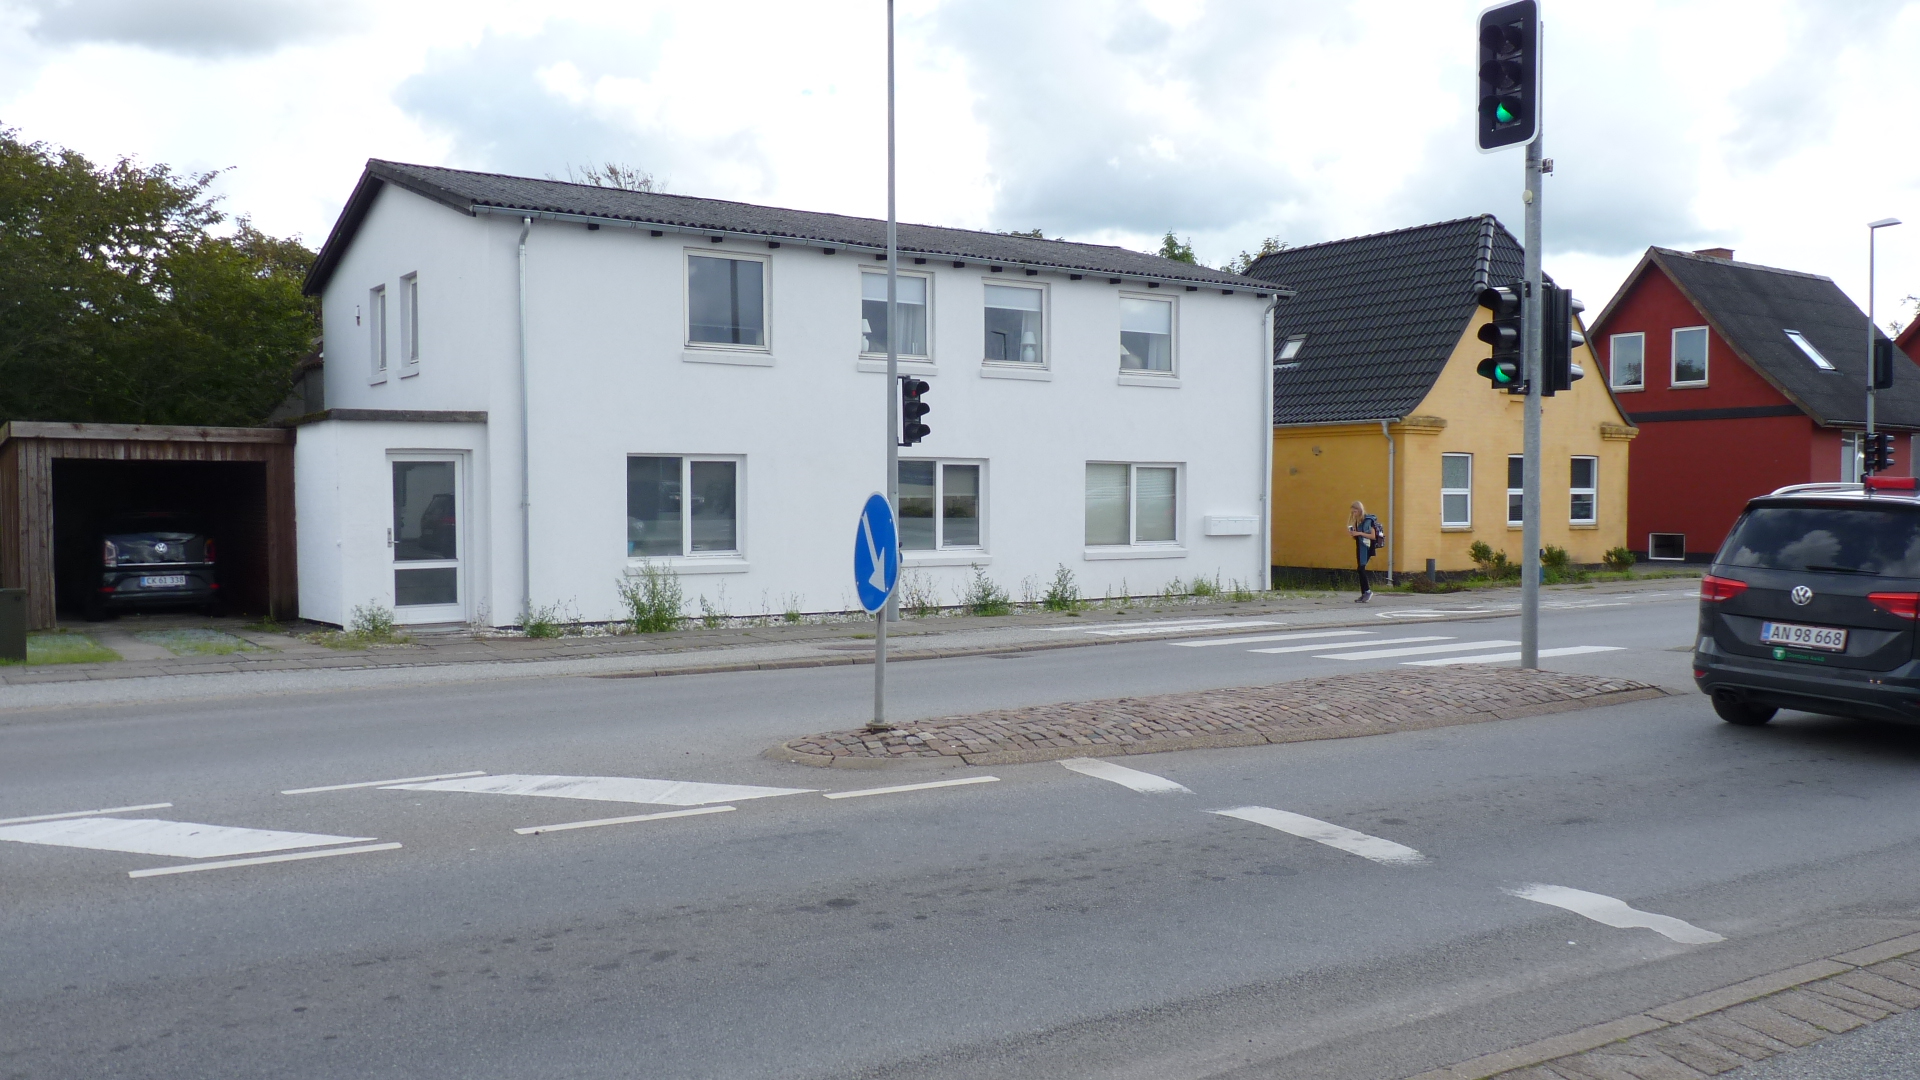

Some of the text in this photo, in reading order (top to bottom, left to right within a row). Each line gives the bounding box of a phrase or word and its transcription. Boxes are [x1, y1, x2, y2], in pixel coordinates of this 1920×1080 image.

[146, 577, 157, 585] CK
[170, 576, 184, 584] 338
[1771, 626, 1792, 640] AN
[1794, 628, 1812, 642] 98
[1814, 630, 1842, 646] 668
